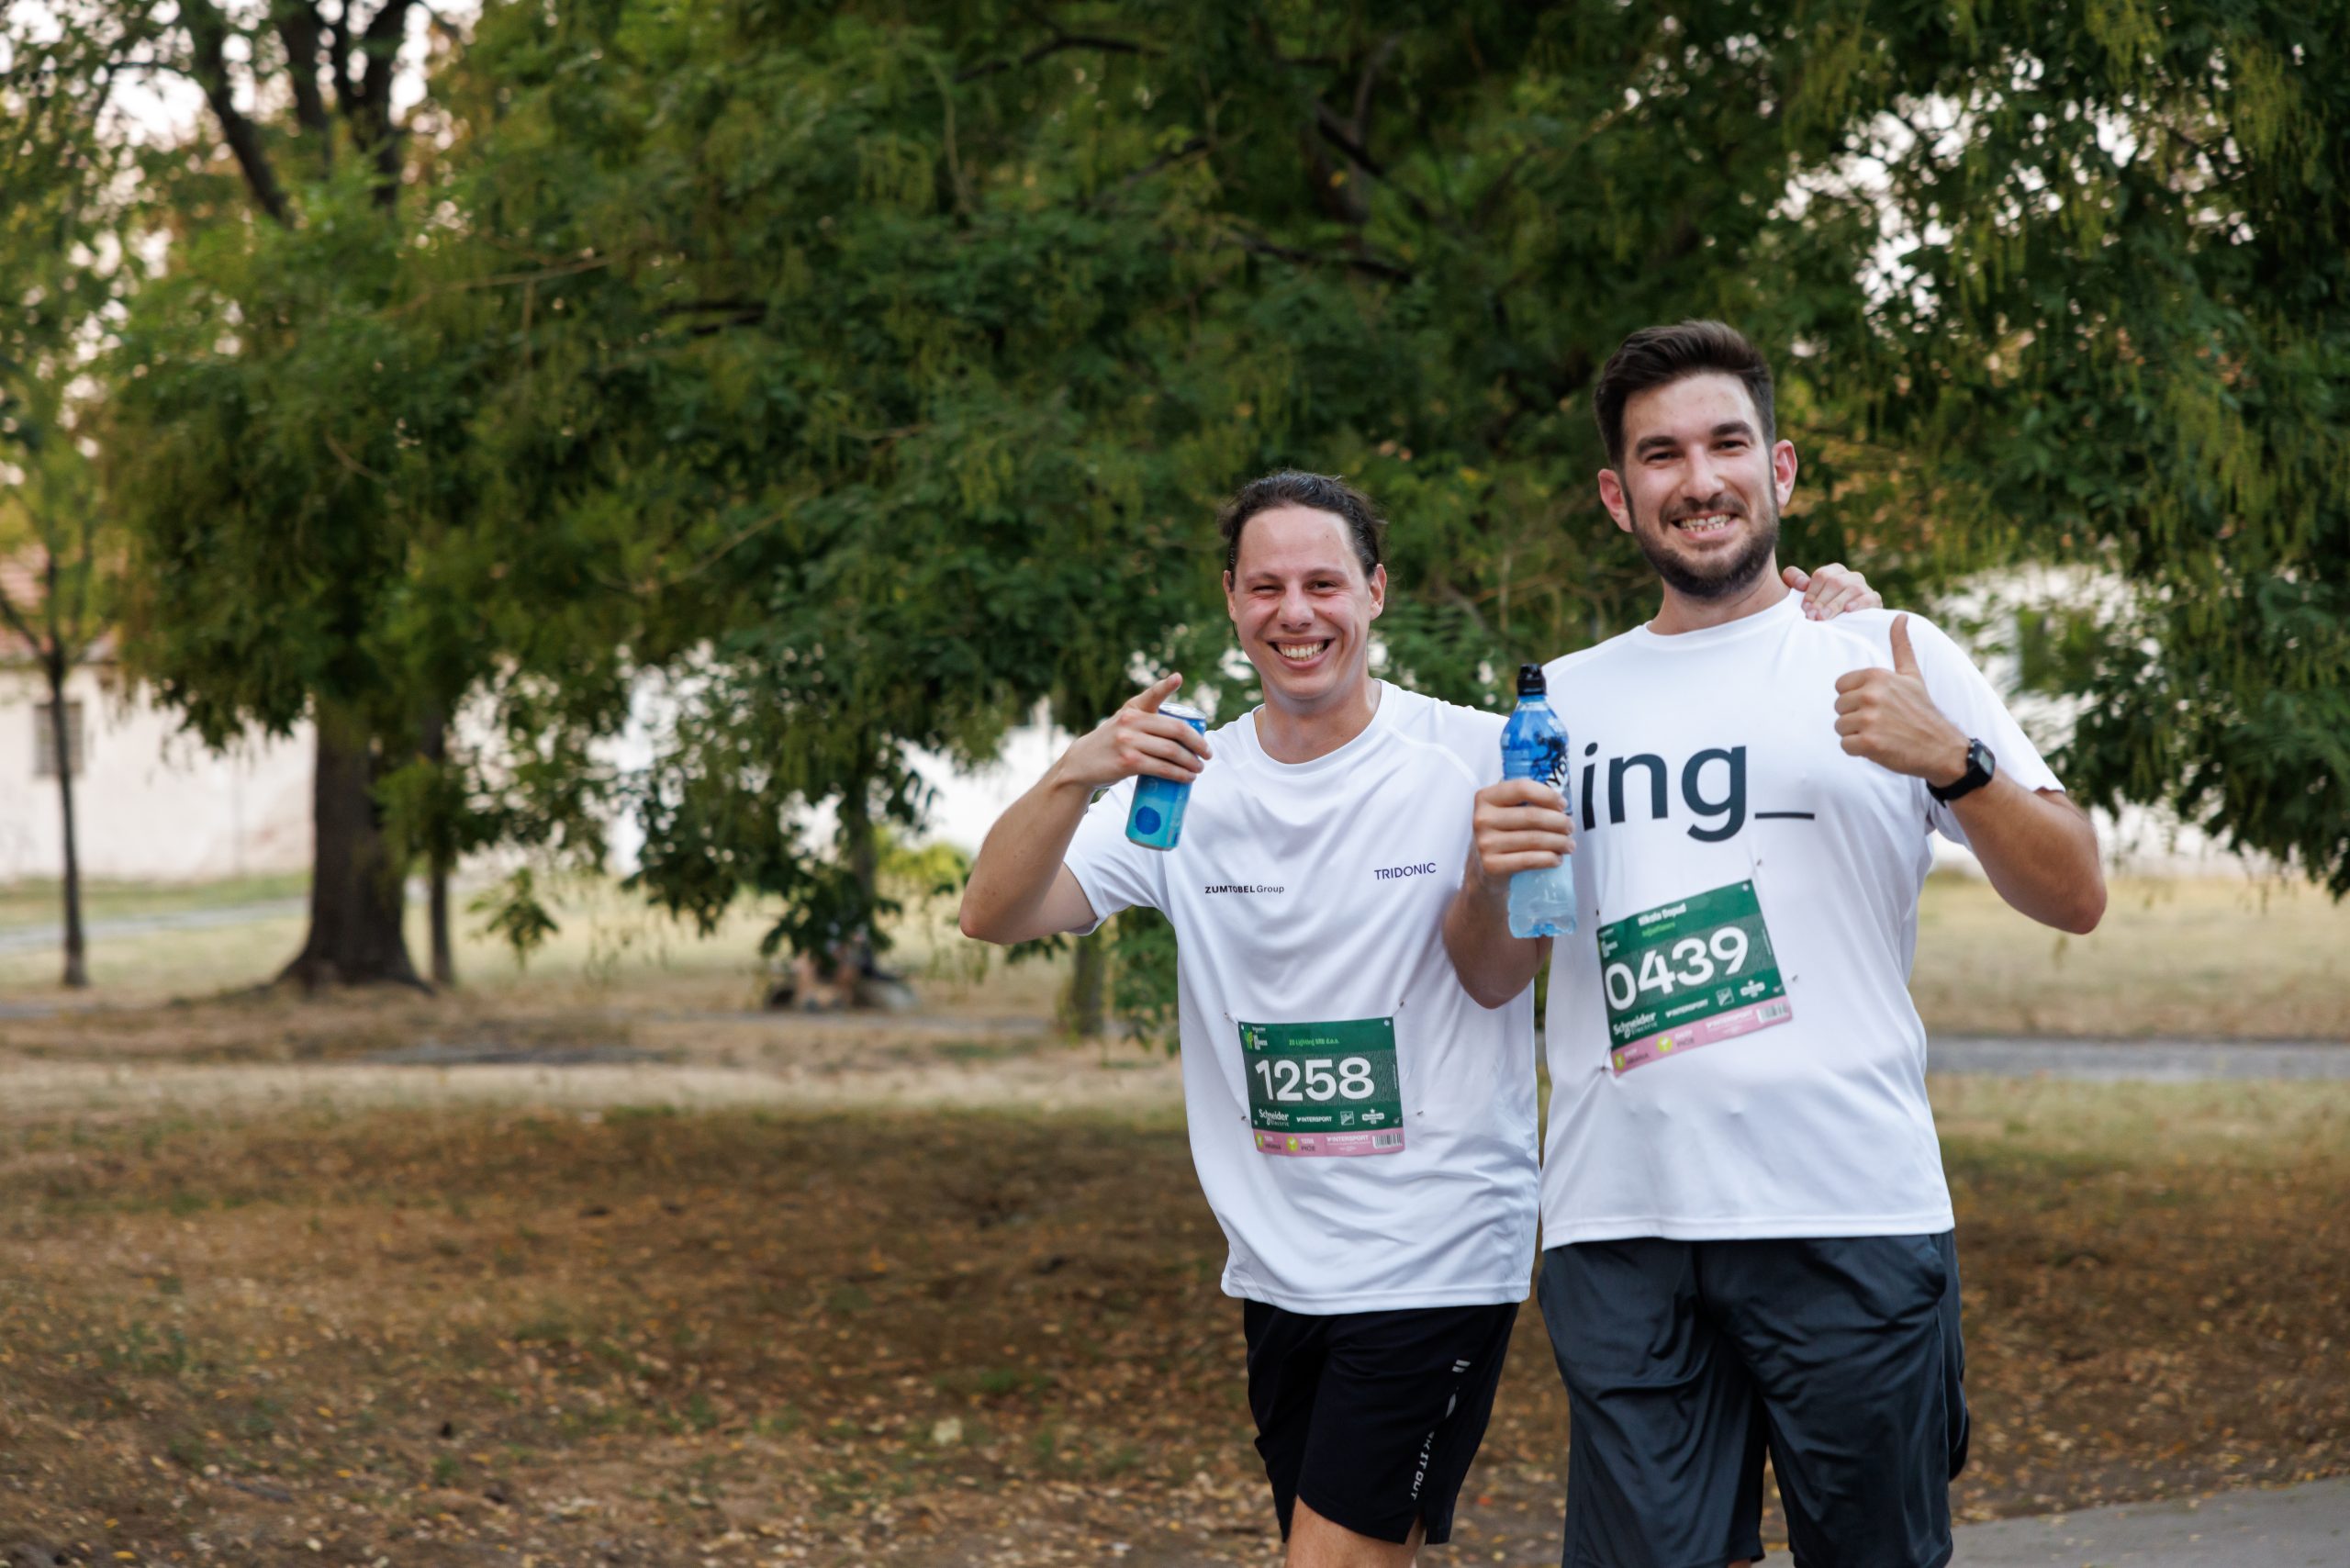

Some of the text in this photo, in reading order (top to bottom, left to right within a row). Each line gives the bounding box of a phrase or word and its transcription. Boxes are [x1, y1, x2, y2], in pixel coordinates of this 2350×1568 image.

[1374, 862, 1437, 880] TRIDONIC
[1204, 885, 1285, 894] ZUMTOBEL Group
[1605, 926, 1749, 1011] 0439
[1613, 1011, 1657, 1038] Schneider
[1255, 1057, 1375, 1102] 1258
[1259, 1108, 1290, 1126] Schneider
[1411, 1471, 1425, 1501] OUT
